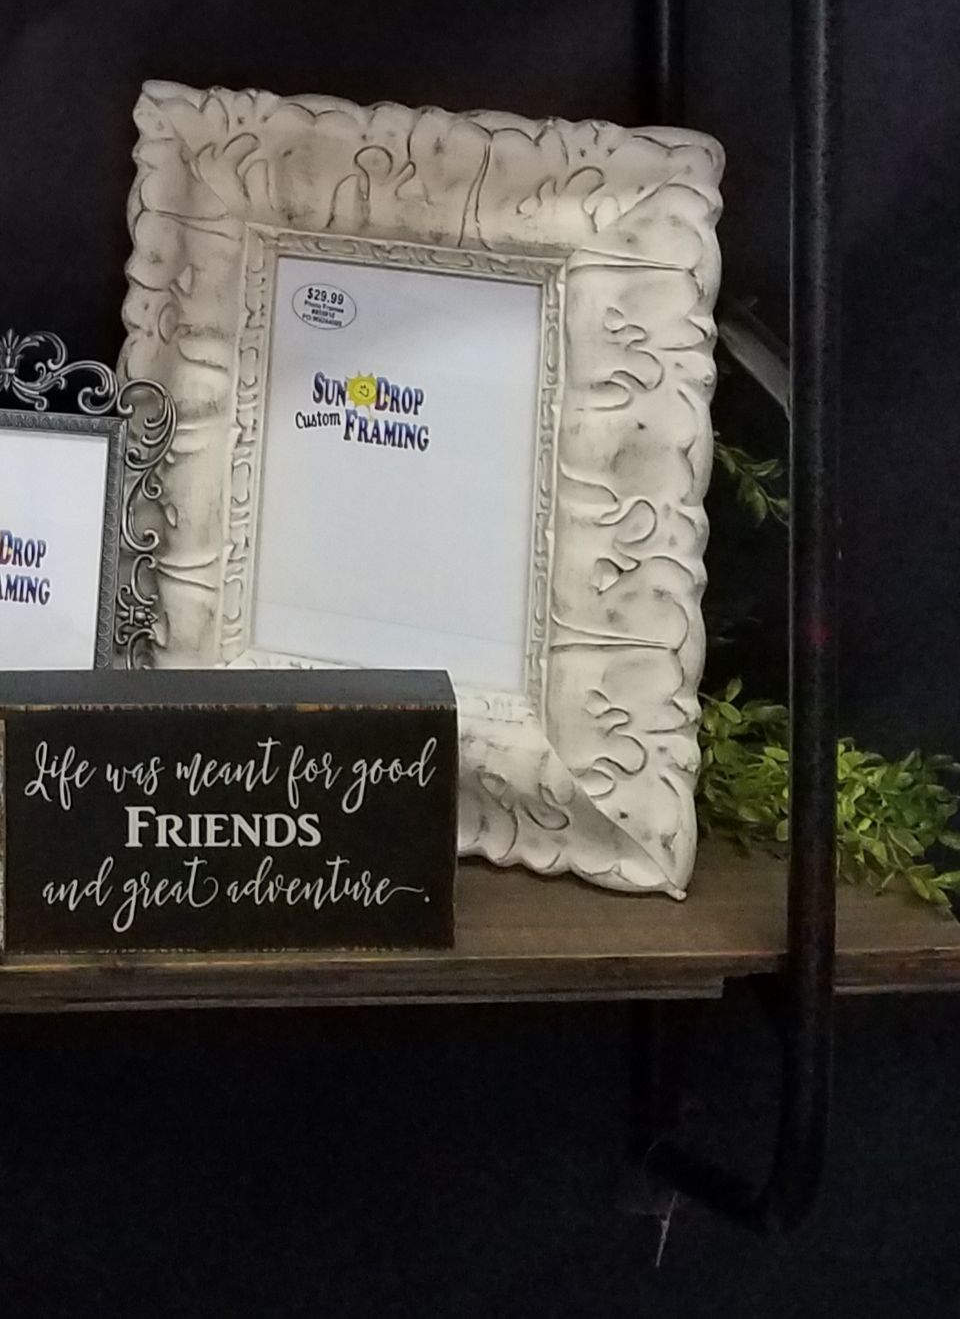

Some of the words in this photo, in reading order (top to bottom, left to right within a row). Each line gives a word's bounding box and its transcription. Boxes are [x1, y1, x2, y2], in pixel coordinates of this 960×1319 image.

[307, 287, 344, 305] $29.99
[312, 371, 348, 407] SUN
[375, 376, 424, 416] DROP
[295, 411, 341, 429] Custom
[343, 408, 430, 452] FRAMING
[24, 741, 97, 810] Life
[106, 756, 166, 795] was
[176, 737, 282, 796] meant
[288, 745, 343, 809] for
[342, 737, 437, 814] good
[124, 806, 321, 847] FRIENDS
[42, 856, 113, 911] and
[112, 856, 219, 933] great
